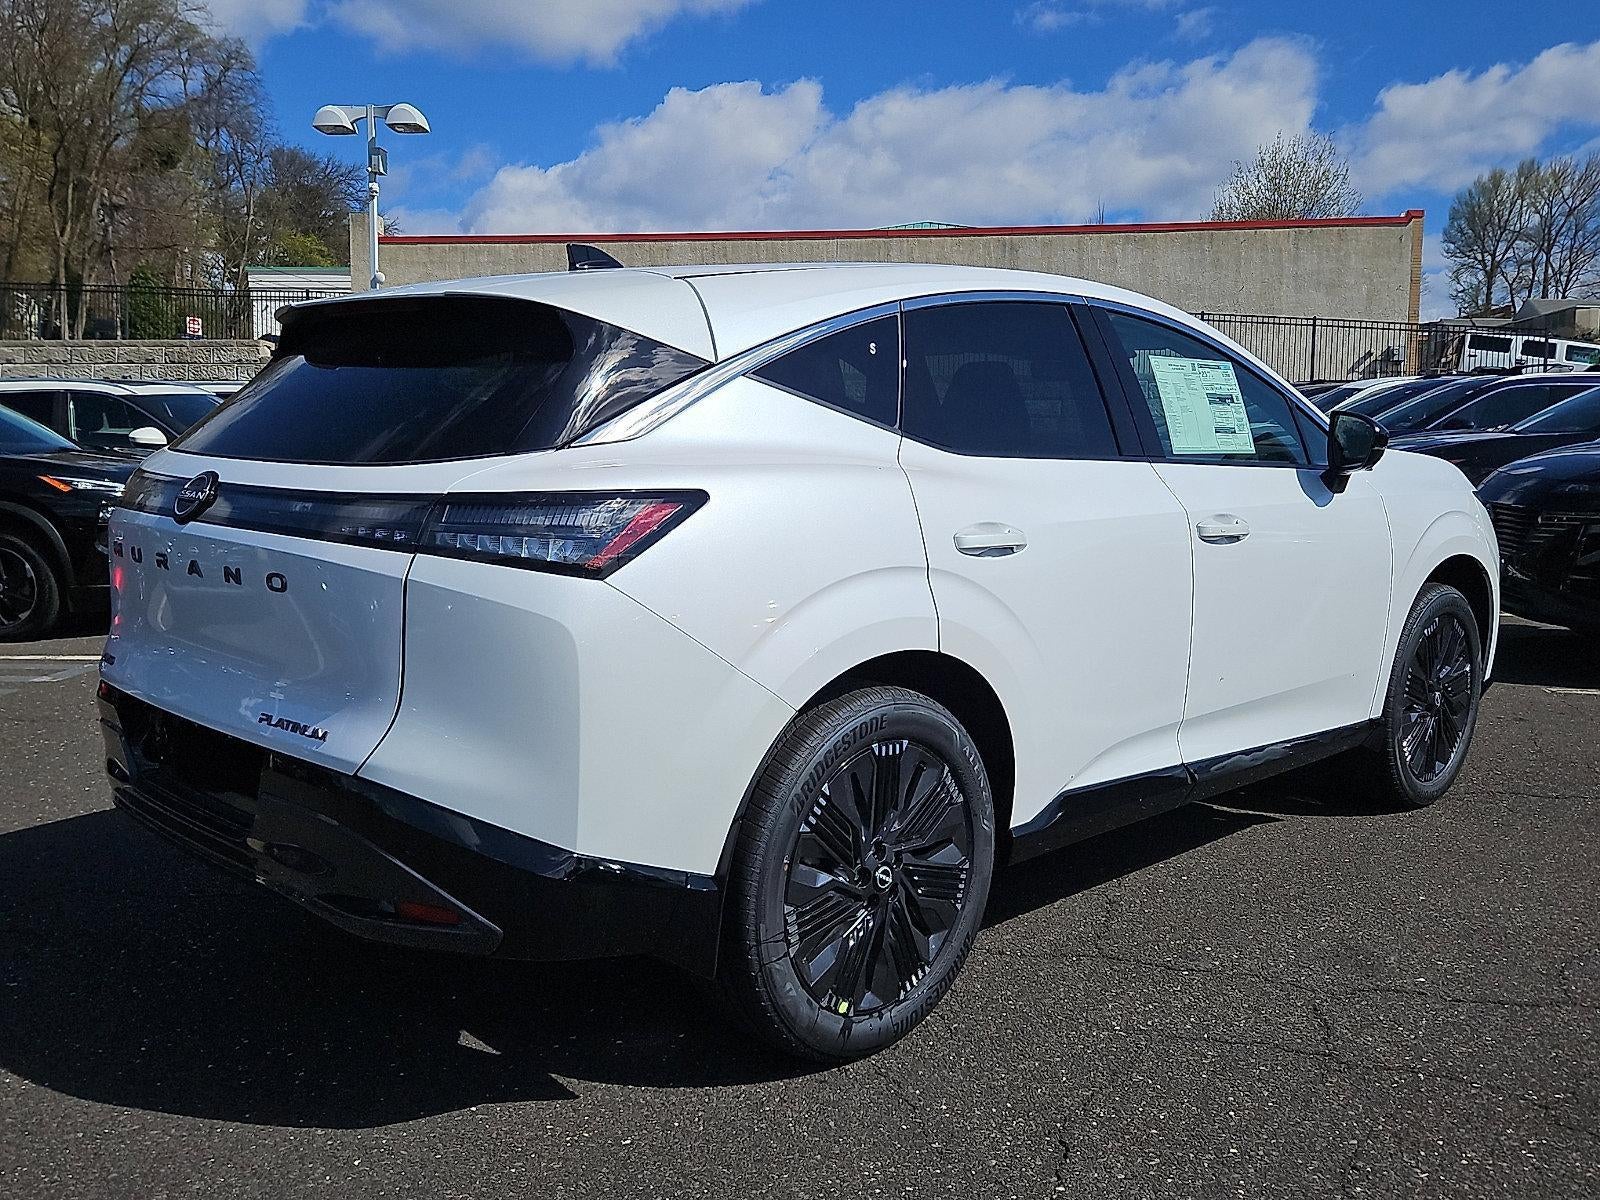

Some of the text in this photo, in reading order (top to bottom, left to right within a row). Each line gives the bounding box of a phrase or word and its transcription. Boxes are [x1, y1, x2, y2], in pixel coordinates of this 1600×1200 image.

[869, 342, 877, 355] S
[113, 540, 288, 593] MURANO
[258, 712, 329, 742] PLATINUM
[789, 713, 888, 818] BRIDGESTONE
